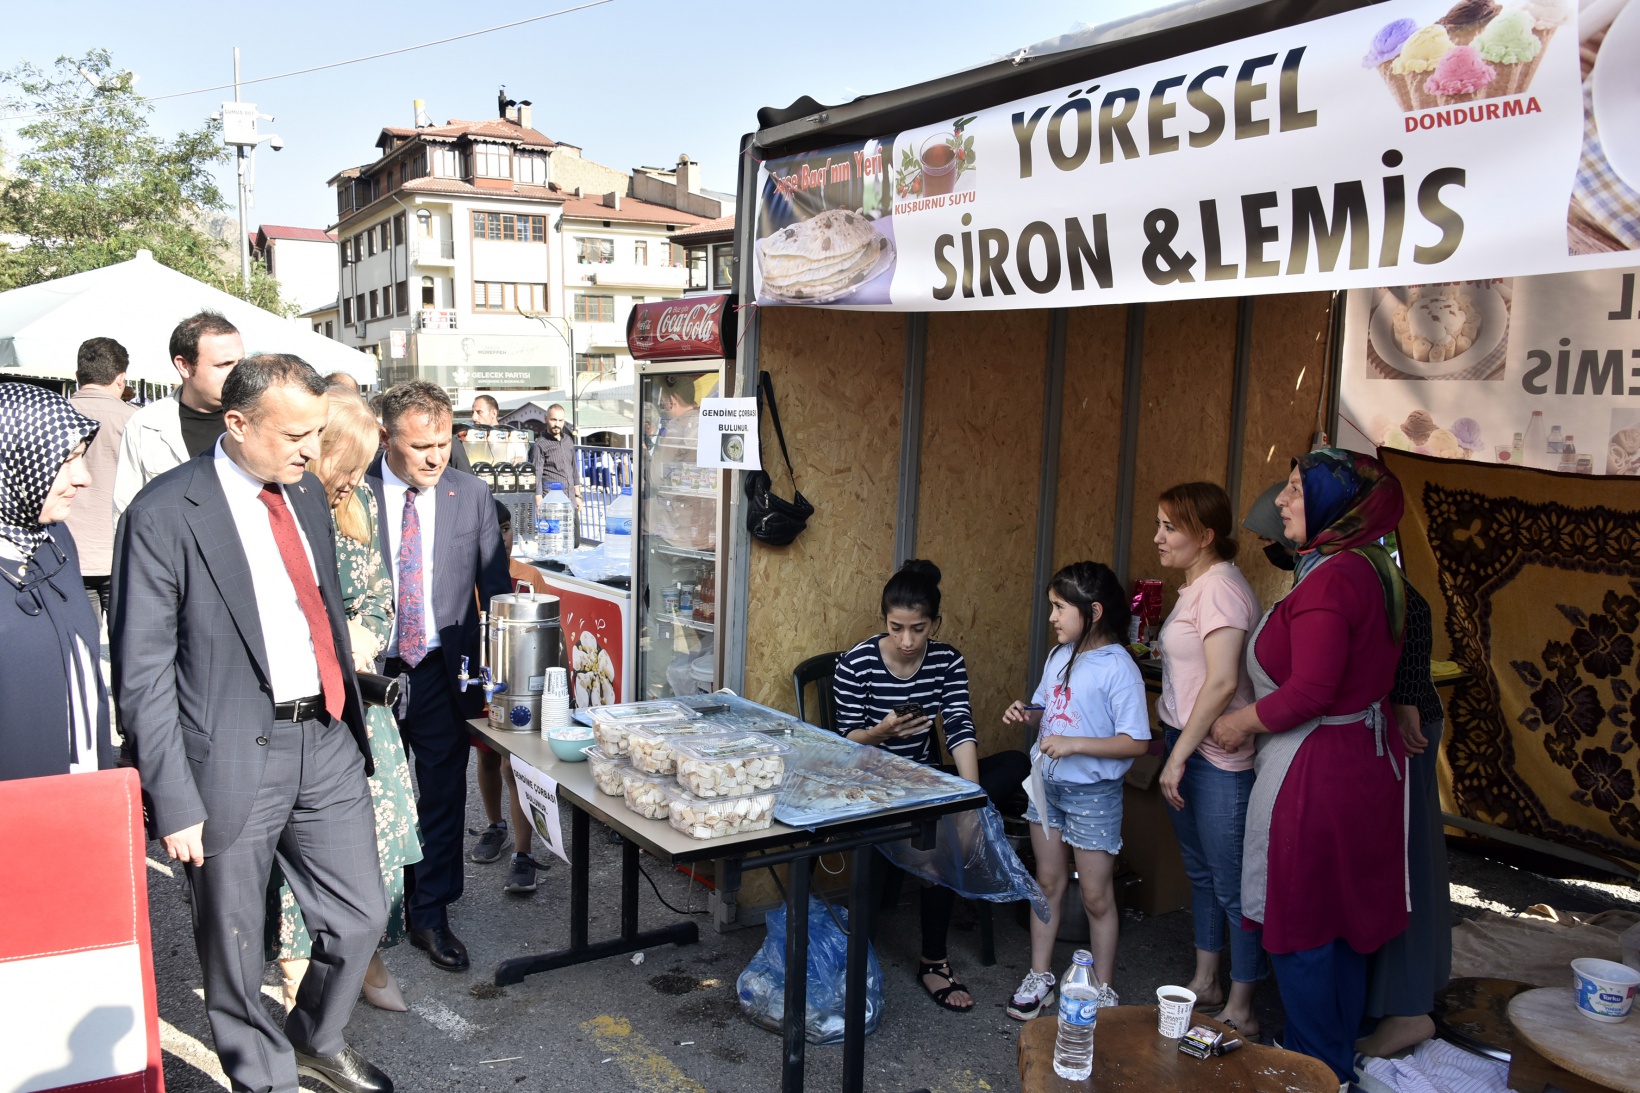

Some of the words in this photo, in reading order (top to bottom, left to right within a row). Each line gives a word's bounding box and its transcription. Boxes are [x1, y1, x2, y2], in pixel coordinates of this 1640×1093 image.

[1011, 46, 1318, 179] YÖRESEL
[1404, 96, 1542, 133] DONDURMA
[853, 145, 883, 178] Yeri
[894, 197, 946, 216] KUŞBURNU
[948, 191, 976, 205] SUYU
[931, 212, 1114, 301] SİRON
[656, 303, 721, 342] Coca-Cola
[472, 371, 504, 379] GELECEK
[702, 408, 737, 417] GENDİME
[738, 409, 757, 419] ÇORBASI
[1602, 994, 1621, 1002] Torku
